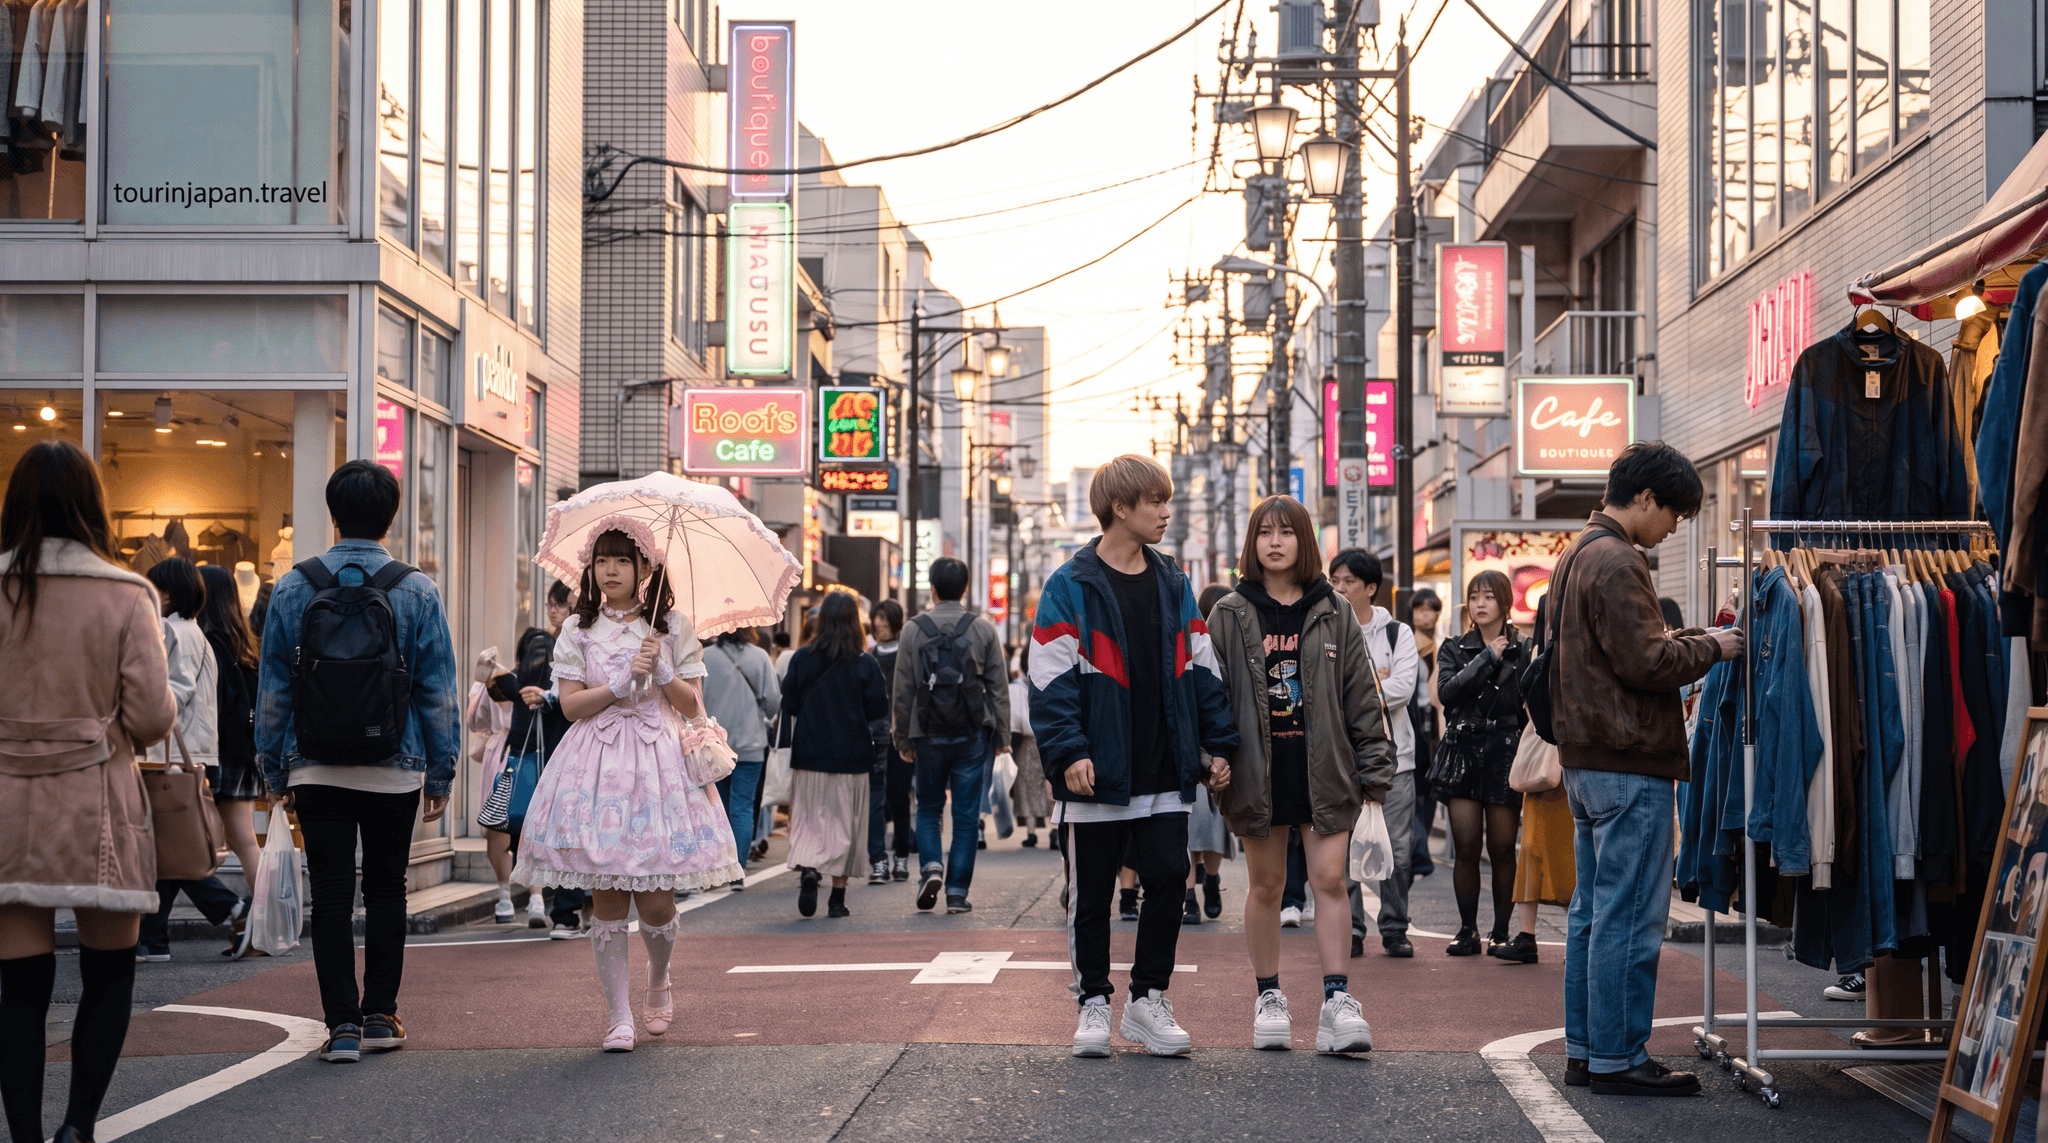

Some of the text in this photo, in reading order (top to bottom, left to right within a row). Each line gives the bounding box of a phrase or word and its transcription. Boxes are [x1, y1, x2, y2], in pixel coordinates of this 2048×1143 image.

[692, 402, 799, 434] Roofs
[1530, 396, 1622, 438] Cafe
[715, 439, 776, 462] Cafe
